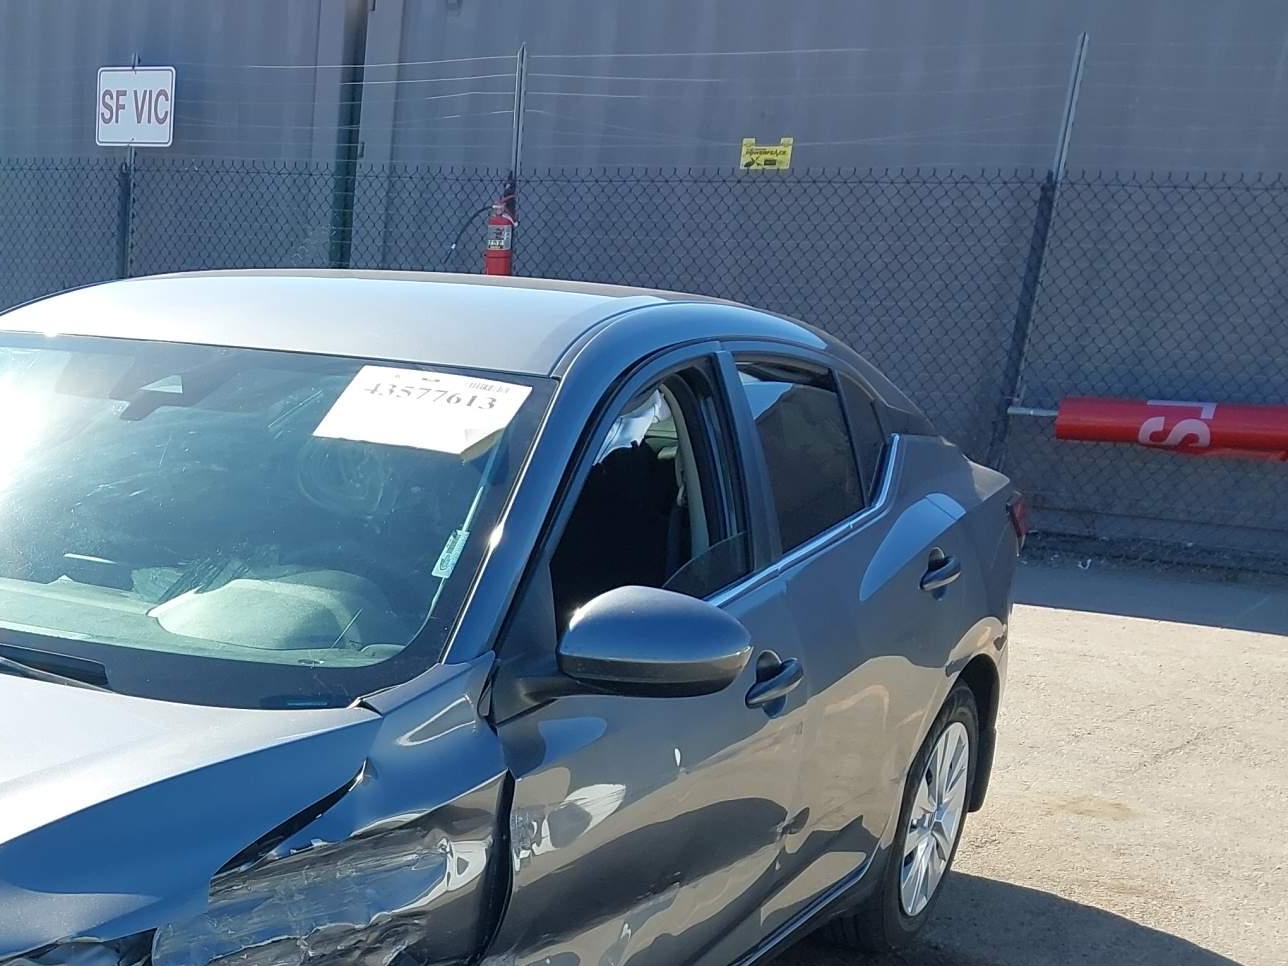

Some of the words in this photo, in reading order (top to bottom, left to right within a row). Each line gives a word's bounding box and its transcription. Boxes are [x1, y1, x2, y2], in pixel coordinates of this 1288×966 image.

[100, 89, 127, 125] SF
[133, 89, 169, 125] VIC
[364, 382, 497, 411] 43577613
